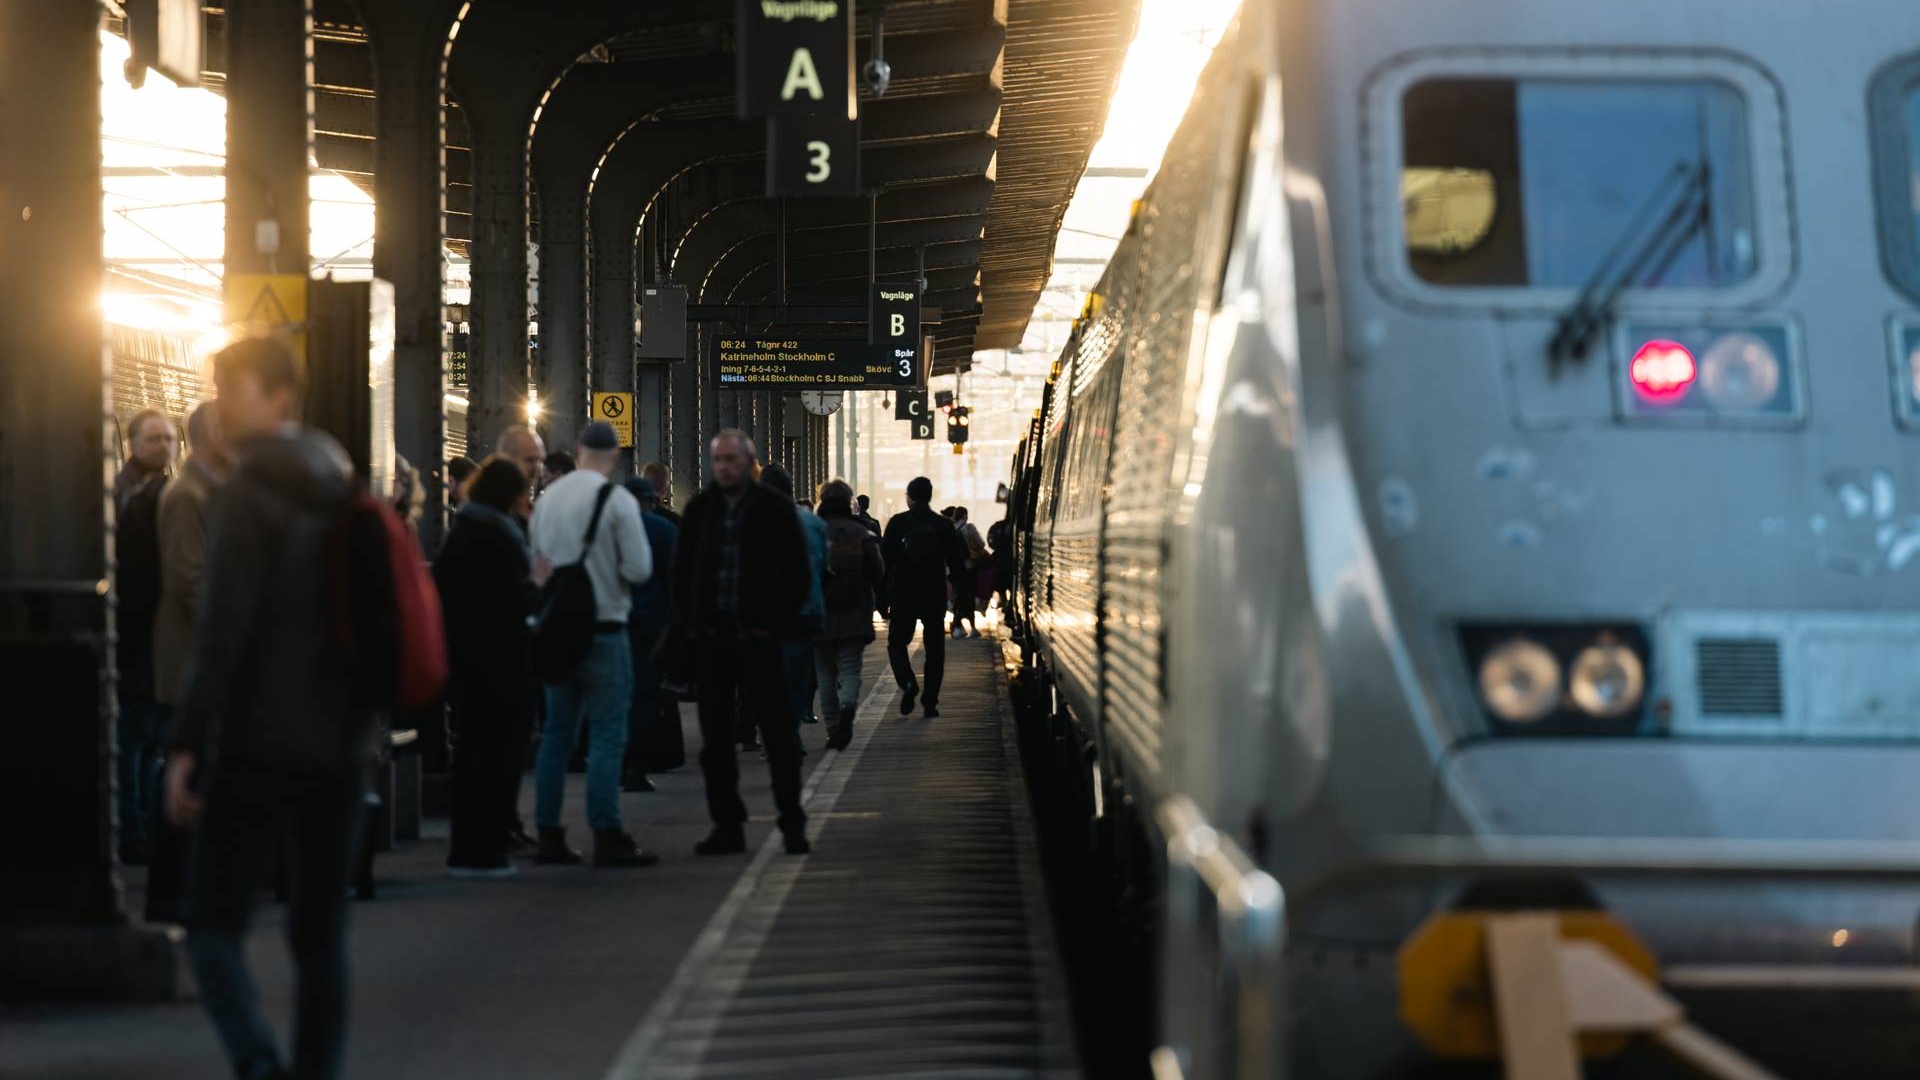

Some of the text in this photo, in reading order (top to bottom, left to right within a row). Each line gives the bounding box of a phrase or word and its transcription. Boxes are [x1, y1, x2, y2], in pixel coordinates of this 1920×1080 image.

[781, 48, 824, 100] A
[805, 140, 831, 183] 3
[881, 291, 914, 301] Vagnläge
[891, 314, 905, 336] B
[721, 341, 798, 350] 06:24 Tågnr 422
[448, 351, 466, 359] 7:24
[721, 352, 836, 361] Katrineholm Stockholm C
[895, 349, 915, 358] Spår
[448, 362, 466, 370] 7:54
[898, 359, 911, 377] 3
[908, 400, 919, 415] C
[920, 424, 930, 437] D
